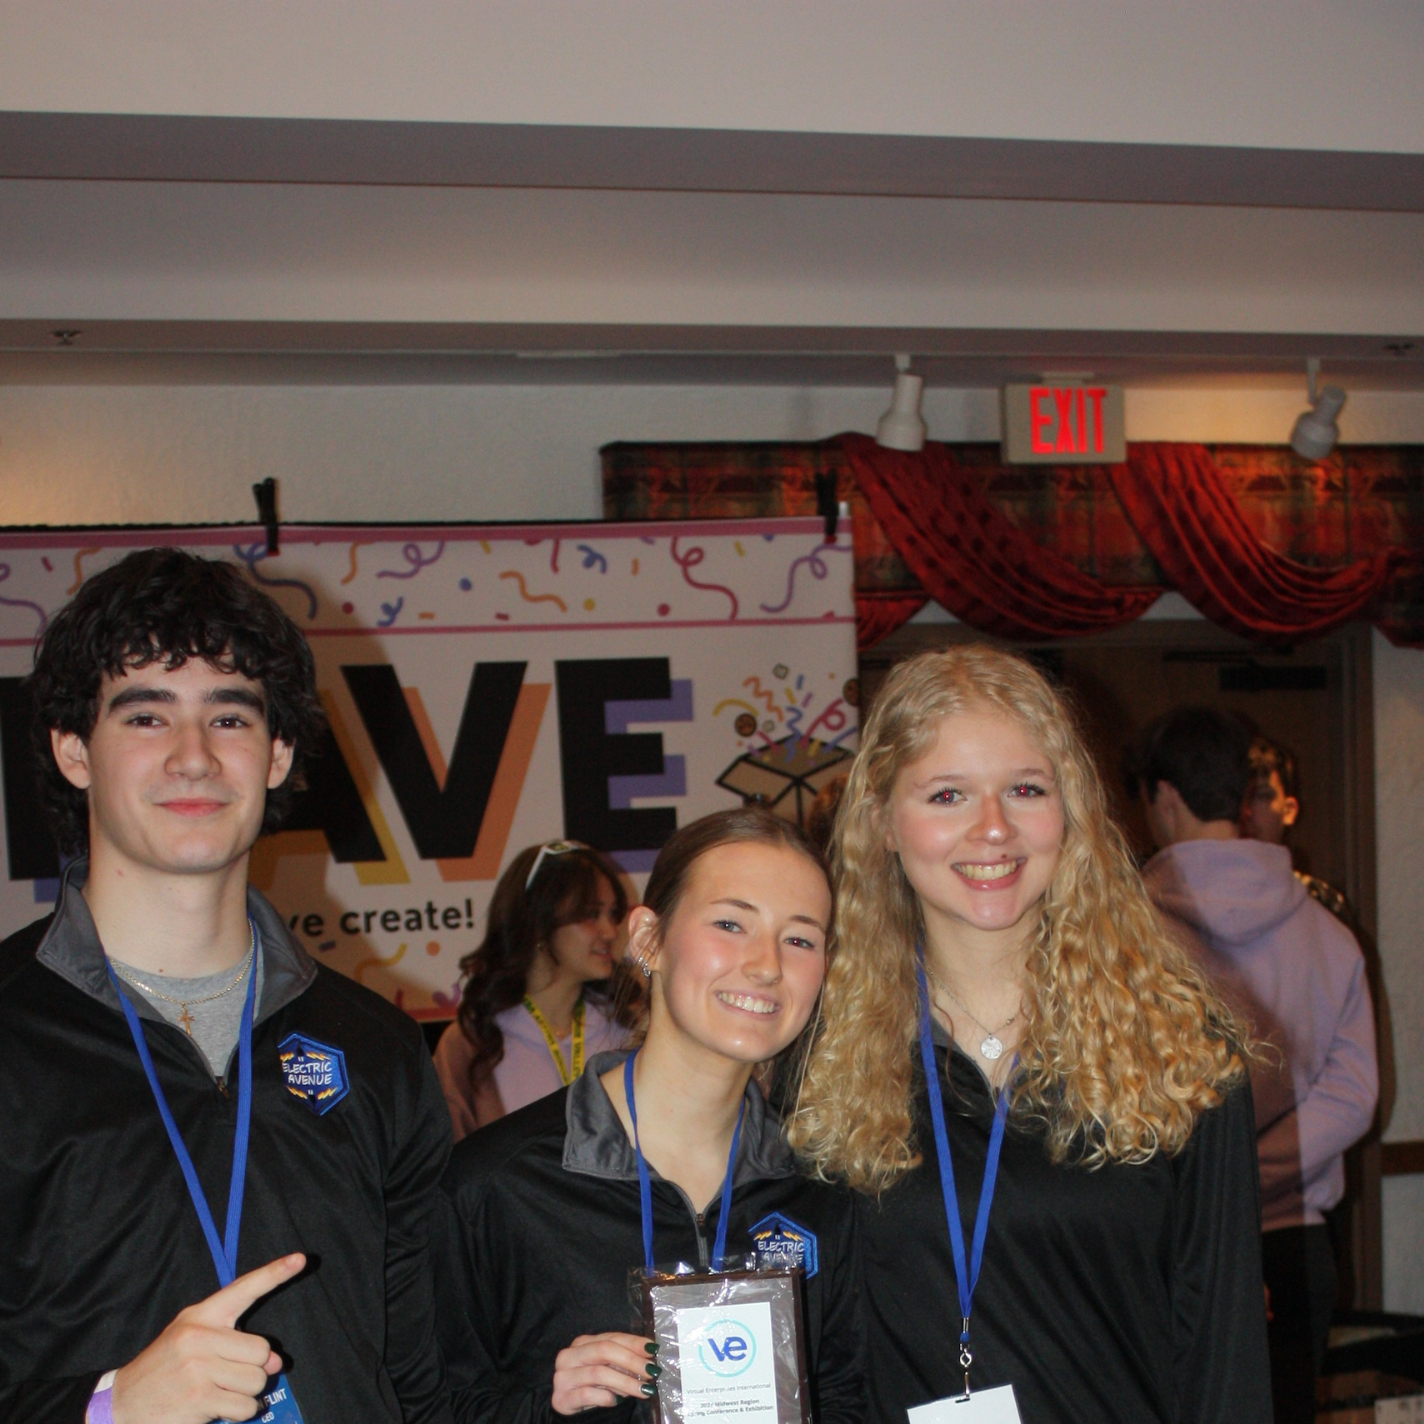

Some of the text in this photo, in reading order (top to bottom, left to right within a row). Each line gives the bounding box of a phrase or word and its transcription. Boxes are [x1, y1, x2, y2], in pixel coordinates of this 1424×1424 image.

[1029, 386, 1107, 454] EXIT
[339, 898, 474, 935] create!
[282, 1061, 333, 1074] ELECTRIC
[287, 1073, 333, 1086] AVENUE
[757, 1240, 805, 1253] ELECTRIC
[686, 1387, 704, 1395] Virtual
[736, 1383, 771, 1391] International
[264, 1387, 288, 1407] FLINT
[740, 1398, 760, 1406] Region
[706, 1407, 739, 1416] Conference
[745, 1404, 774, 1413] Exhibition
